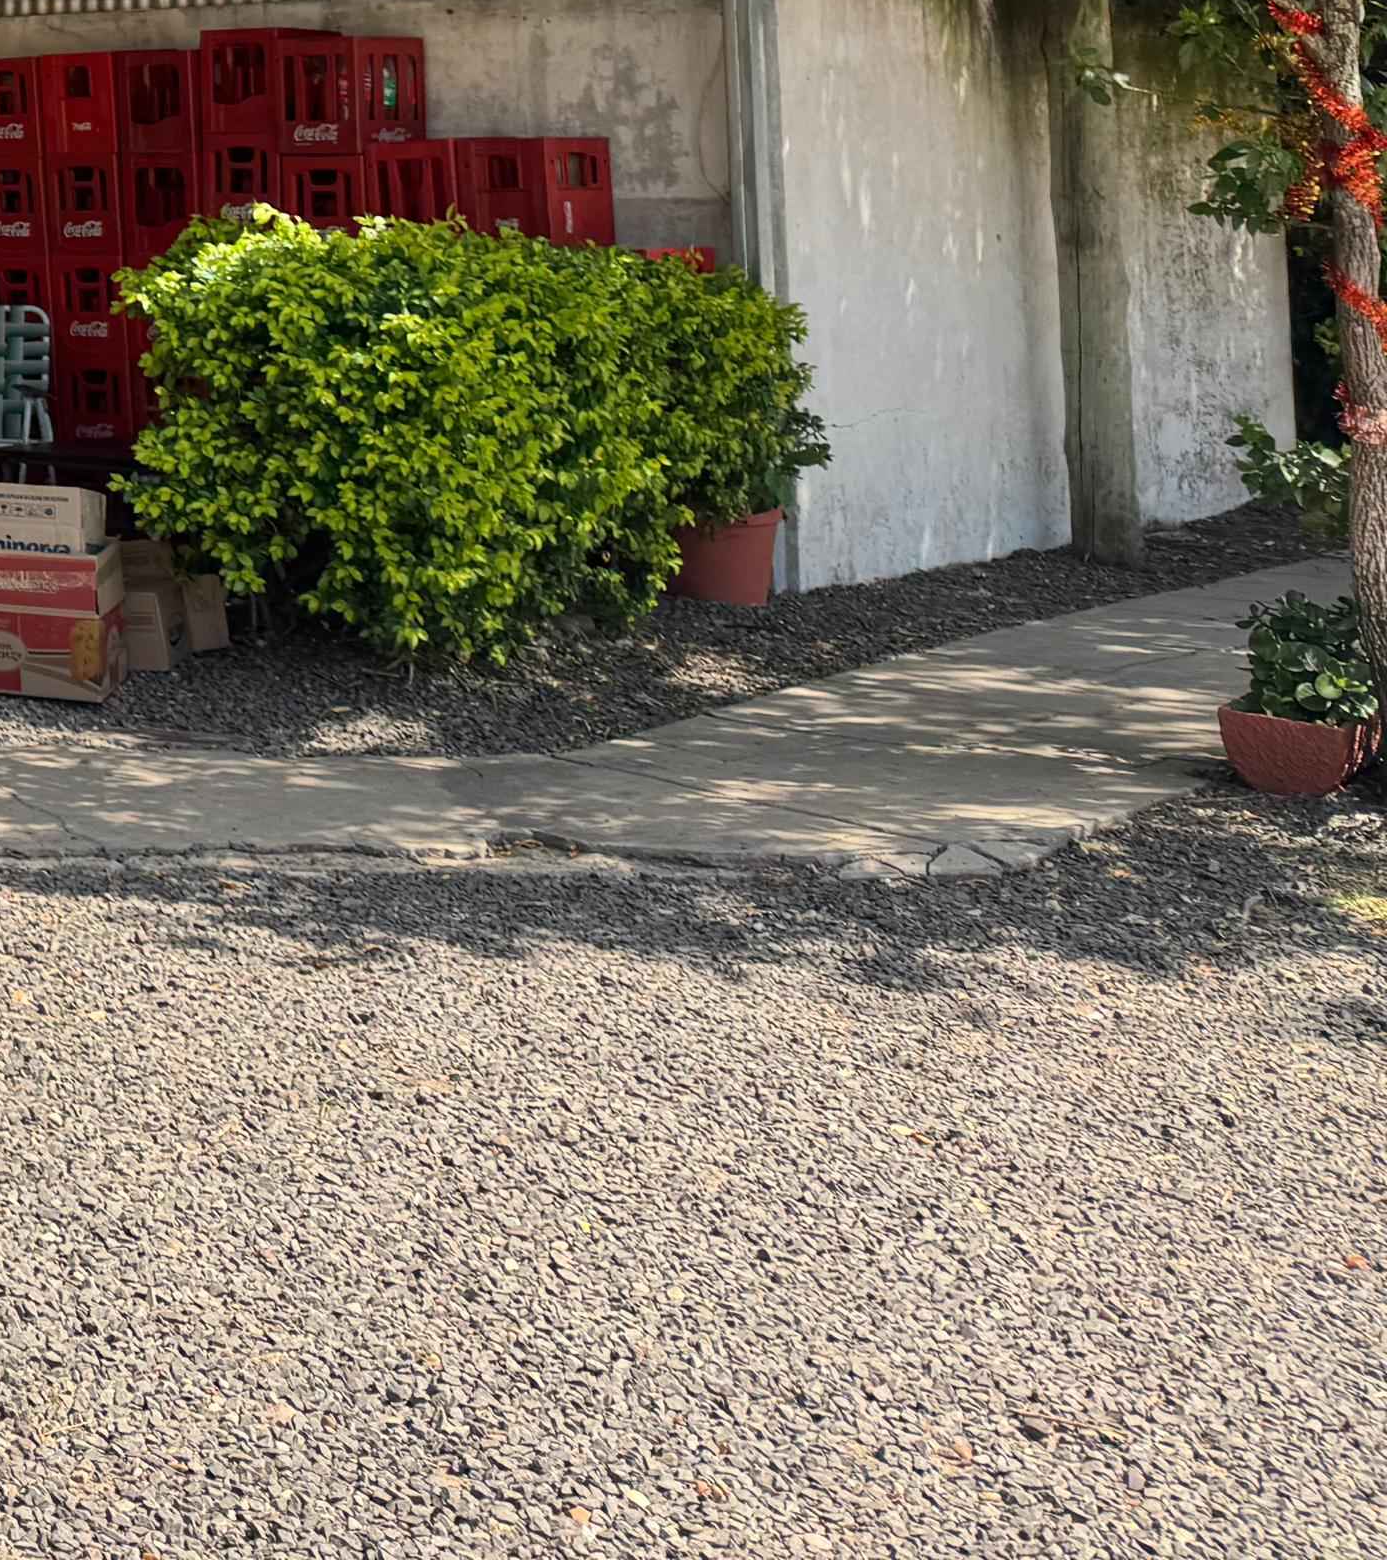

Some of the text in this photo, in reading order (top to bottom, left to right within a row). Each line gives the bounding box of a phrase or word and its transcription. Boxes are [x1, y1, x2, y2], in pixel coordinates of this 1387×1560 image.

[293, 123, 340, 144] Coca-Cola
[63, 220, 103, 238] Coca-Cola
[69, 320, 108, 338] Coca-Cola
